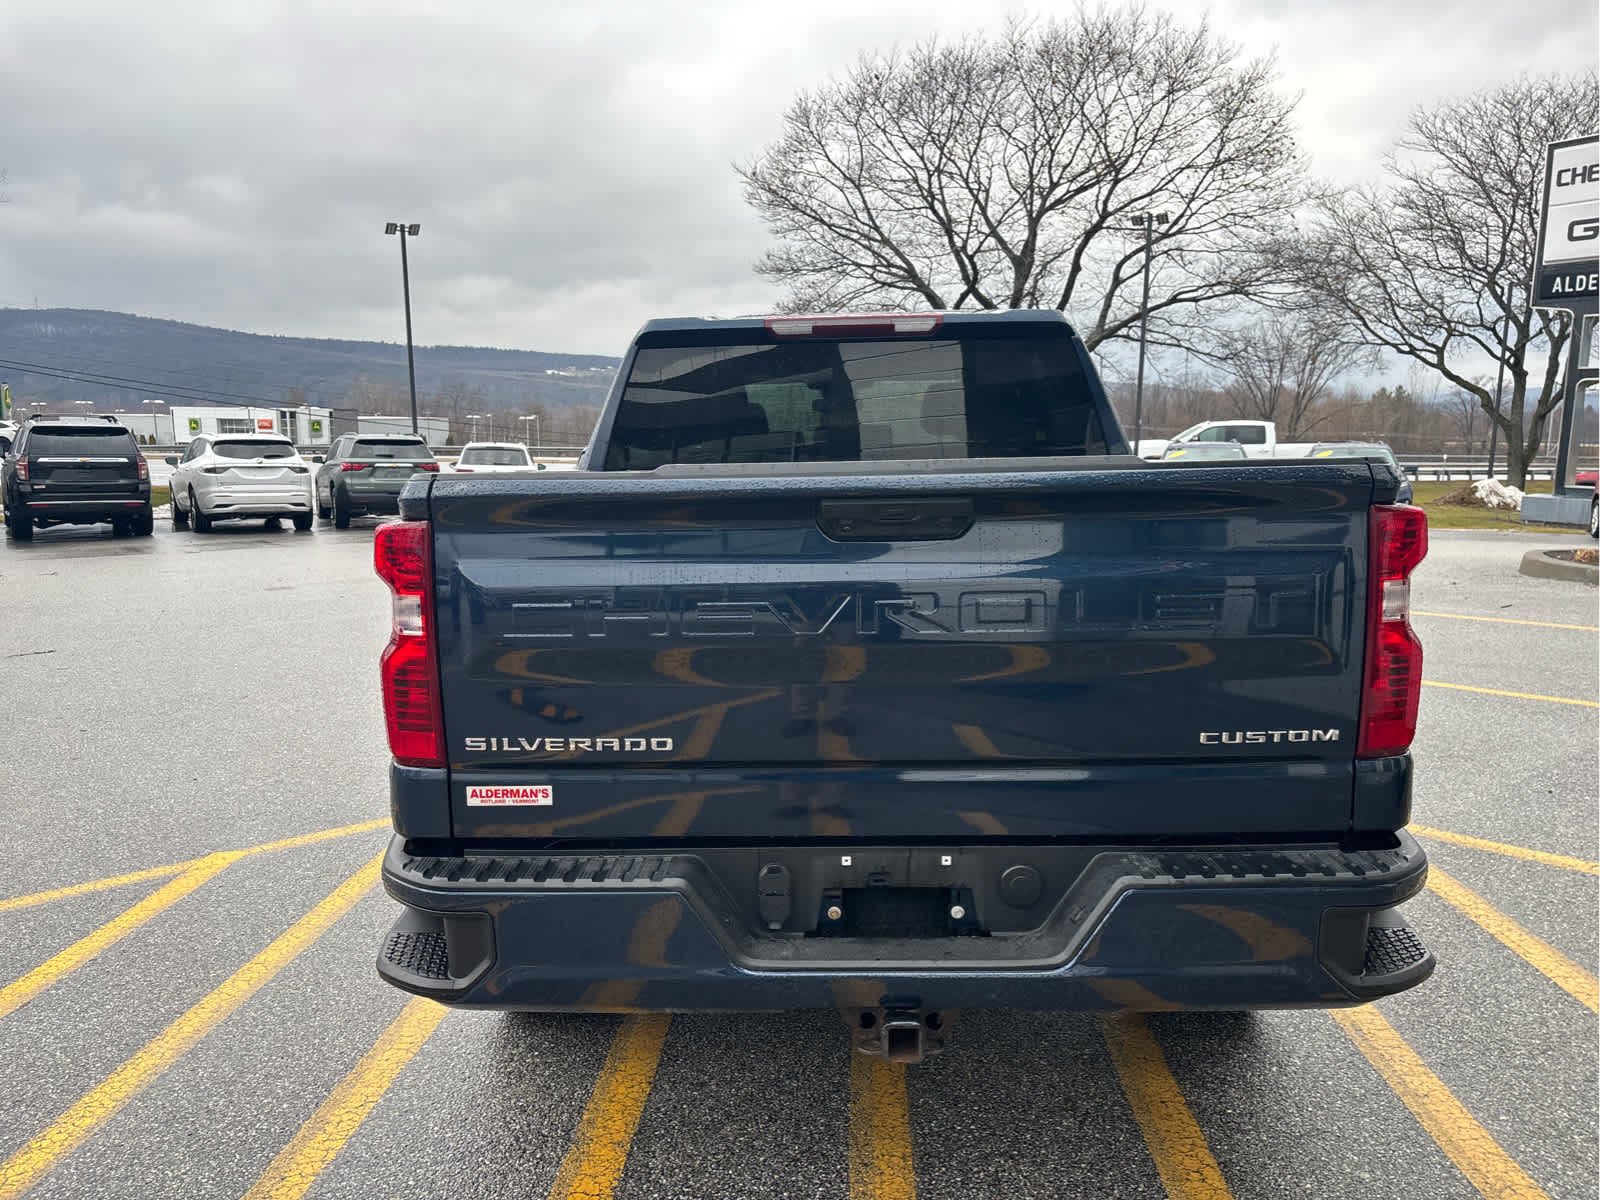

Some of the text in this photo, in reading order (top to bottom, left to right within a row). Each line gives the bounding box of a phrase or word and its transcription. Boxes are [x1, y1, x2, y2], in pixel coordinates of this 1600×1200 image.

[1552, 274, 1599, 293] ALDE
[502, 592, 1316, 637] CHEVROLET
[464, 737, 673, 751] SILVERADO
[1199, 729, 1340, 744] CUSTOM
[470, 788, 549, 799] ALDERMAN'S
